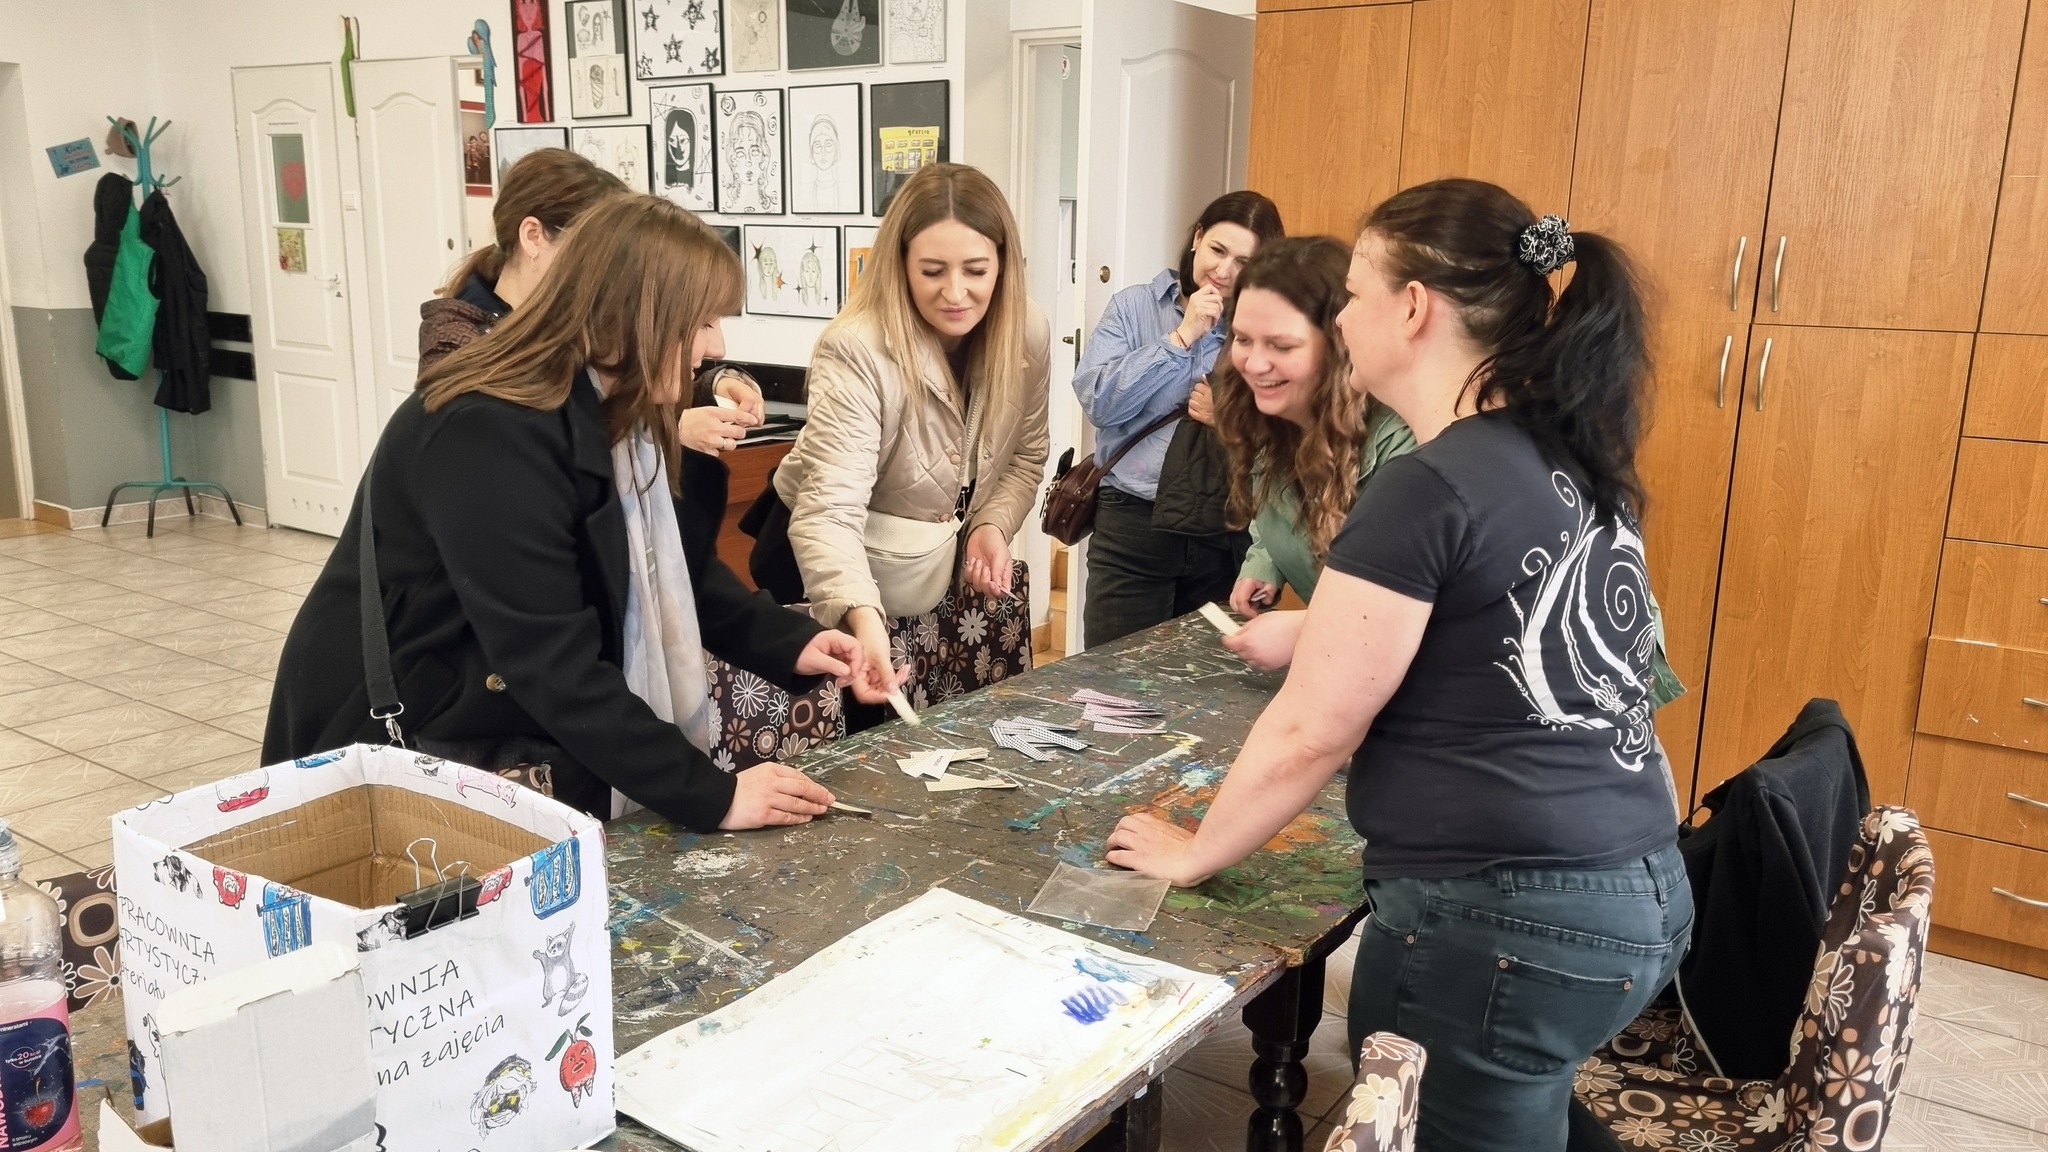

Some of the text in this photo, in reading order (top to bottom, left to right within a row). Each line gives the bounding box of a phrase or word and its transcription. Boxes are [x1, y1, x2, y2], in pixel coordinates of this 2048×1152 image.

[118, 895, 216, 966] PRACOWNIA
[118, 926, 207, 985] ARTYSTYCZ
[367, 959, 460, 1011] WNIA
[17, 1051, 29, 1061] 20
[377, 1014, 505, 1086] na zajęcia
